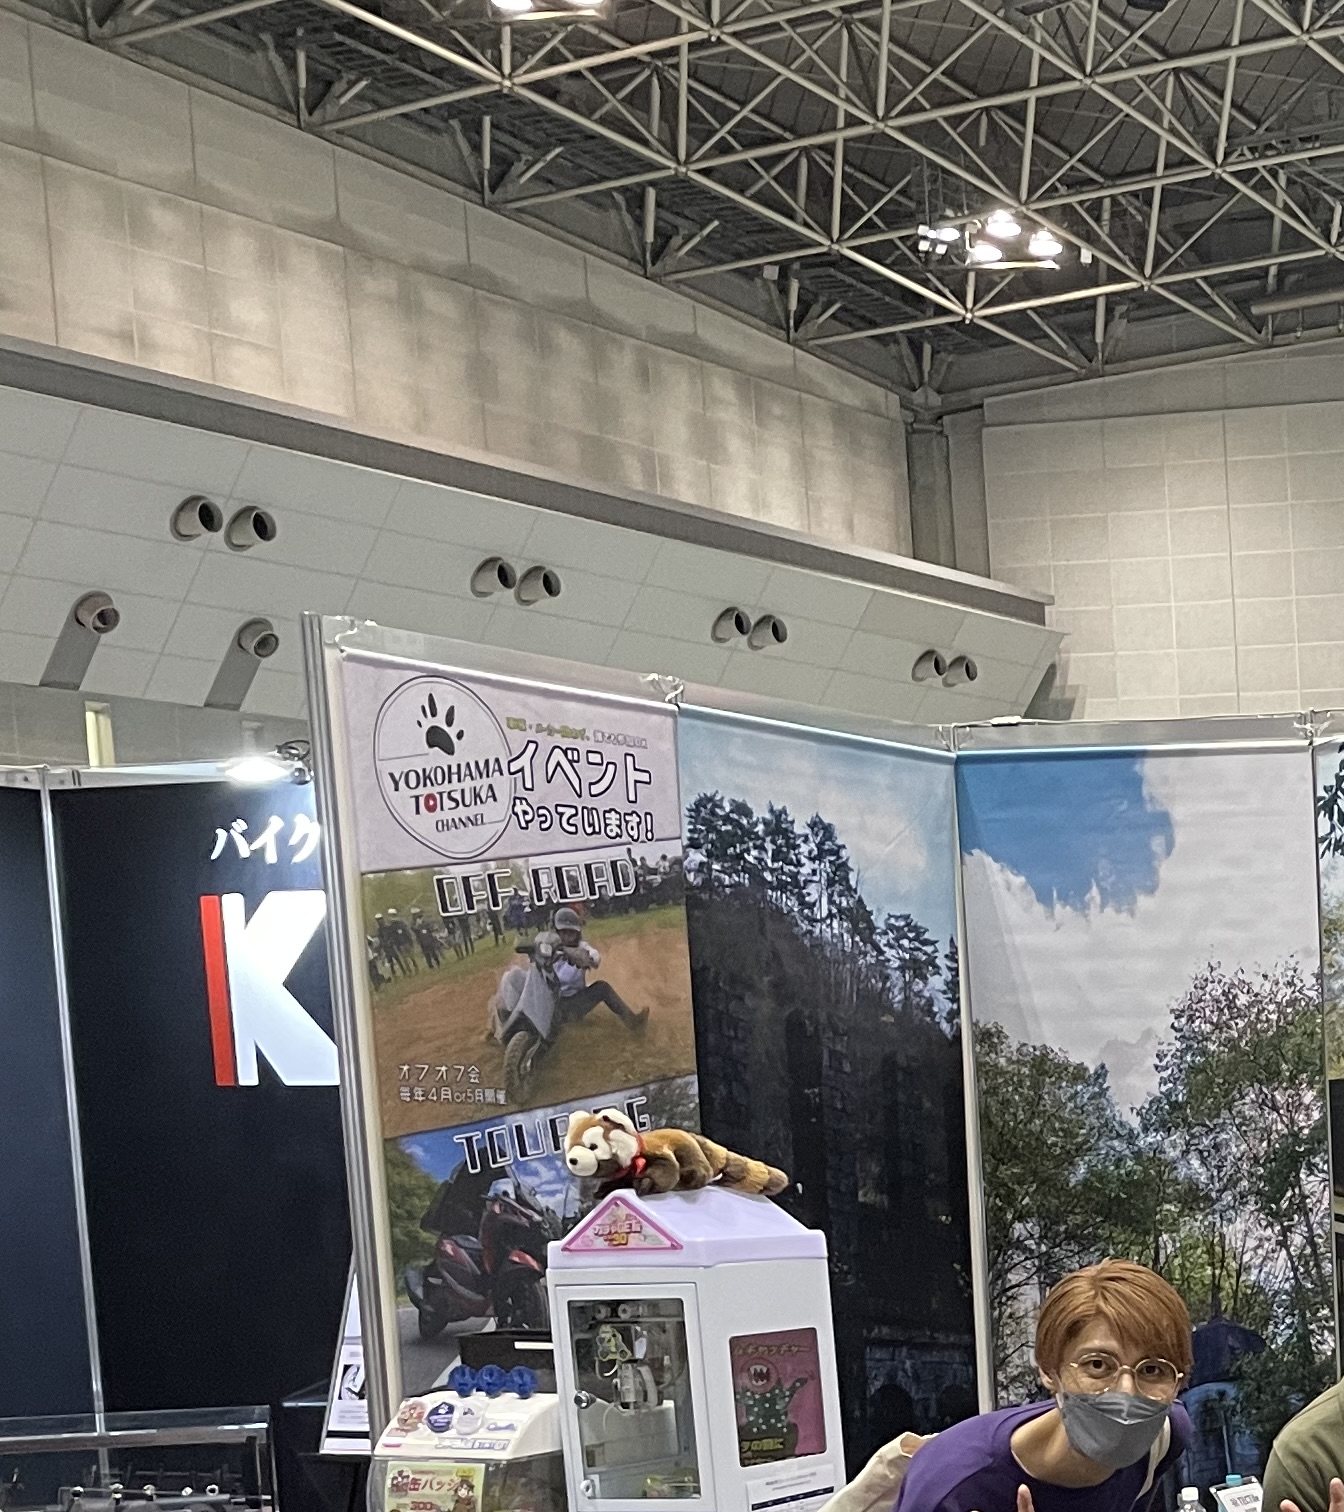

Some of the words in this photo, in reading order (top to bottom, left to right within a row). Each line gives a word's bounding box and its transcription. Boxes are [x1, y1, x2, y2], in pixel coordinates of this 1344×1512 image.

[388, 757, 504, 792] YOKOHAMA
[508, 740, 651, 803] イベント
[435, 812, 486, 834] CHANNEL
[434, 868, 512, 918] OFF
[530, 858, 638, 906] ROAD
